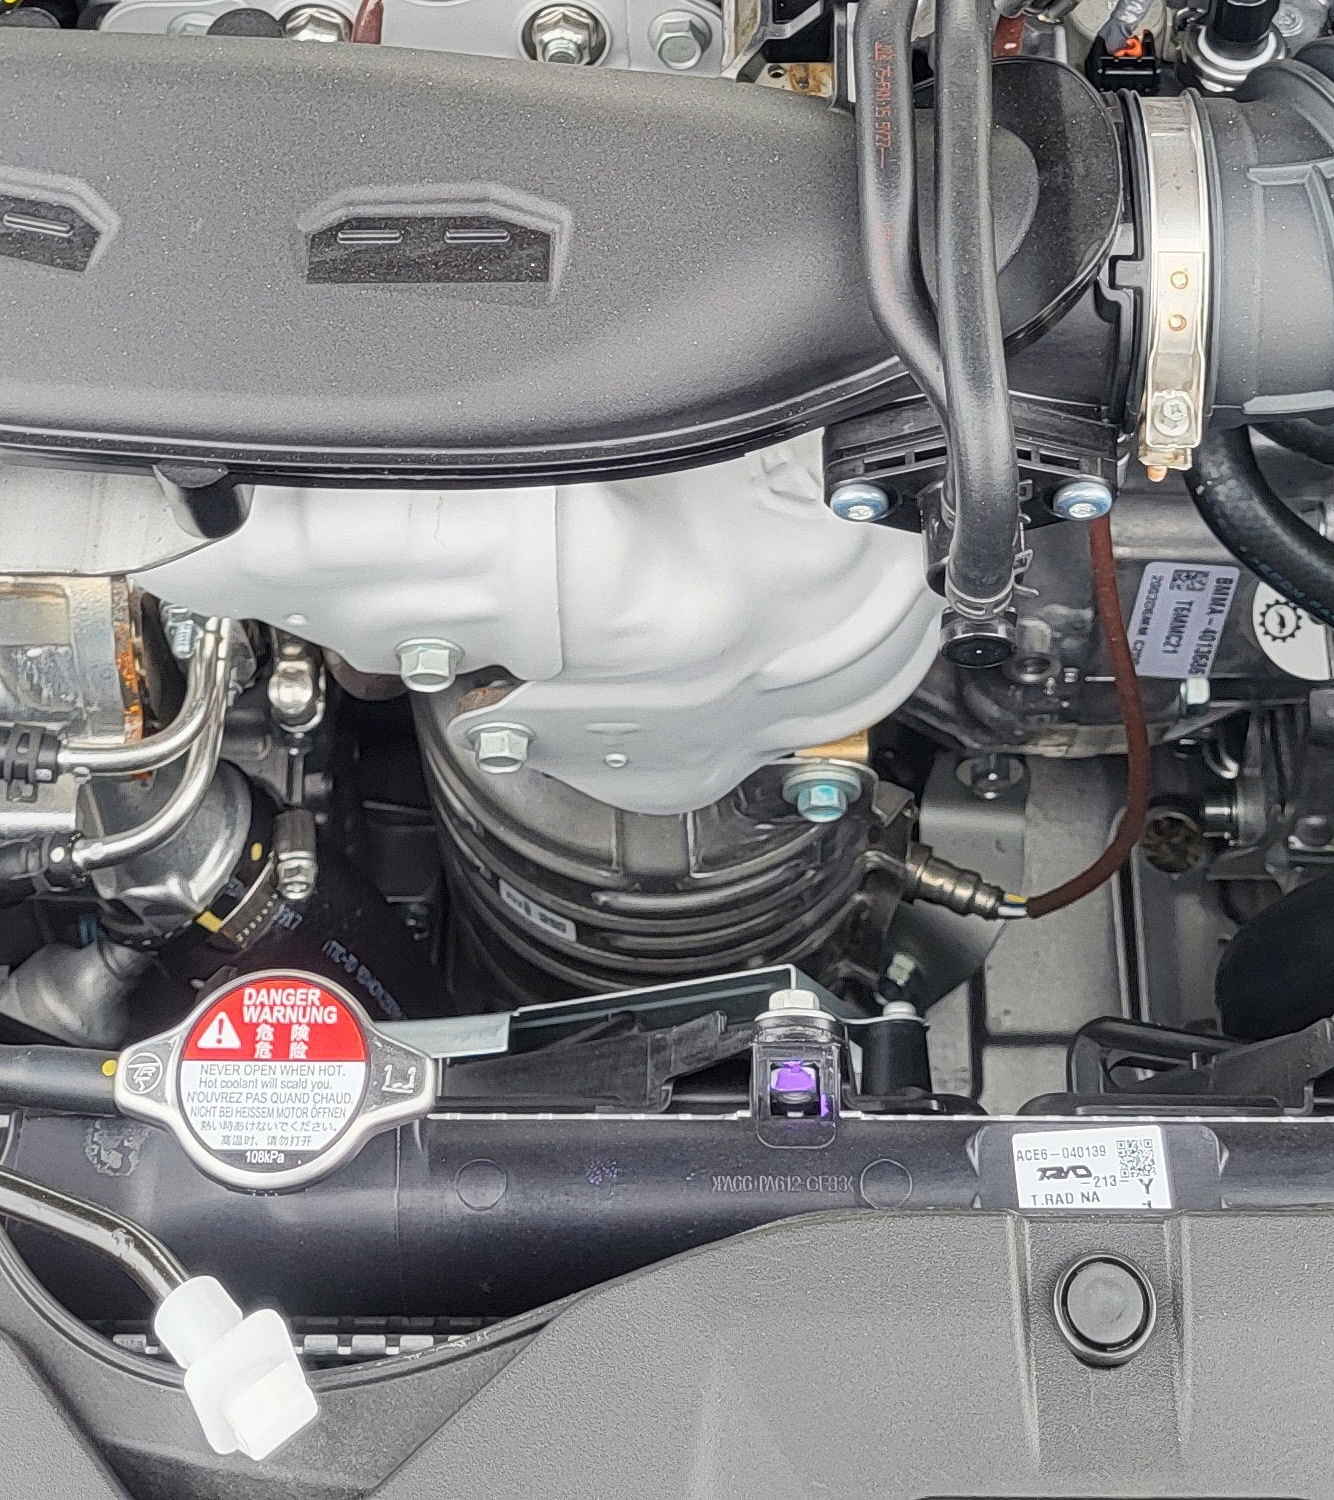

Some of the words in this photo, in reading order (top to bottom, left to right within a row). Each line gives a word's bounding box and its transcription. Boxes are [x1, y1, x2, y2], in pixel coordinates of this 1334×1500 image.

[243, 988, 321, 1006] DANGER
[243, 1005, 337, 1024] WARNUNG
[200, 1064, 241, 1076] NEVER
[244, 1064, 277, 1076] OPEN
[280, 1065, 316, 1076] WHEN
[318, 1065, 346, 1077] HOT.
[199, 1078, 217, 1089] Hot
[221, 1078, 259, 1089] coolant
[261, 1078, 277, 1089] will
[279, 1078, 308, 1089] scald
[310, 1080, 333, 1091] you.
[187, 1092, 242, 1104] N'OUVREZ
[245, 1092, 268, 1104] PAS
[271, 1092, 310, 1104] QUAND
[312, 1092, 354, 1104] CHAUD.
[190, 1106, 217, 1118] NICHT
[219, 1106, 233, 1118] BEI
[235, 1106, 275, 1118] HEISSEM
[277, 1106, 309, 1118] MOTOR
[245, 1151, 285, 1164] 108kPa
[1017, 1145, 1107, 1161] ACE6-040139
[1031, 1193, 1074, 1206] T.RAD
[1081, 1192, 1100, 1203] NA
